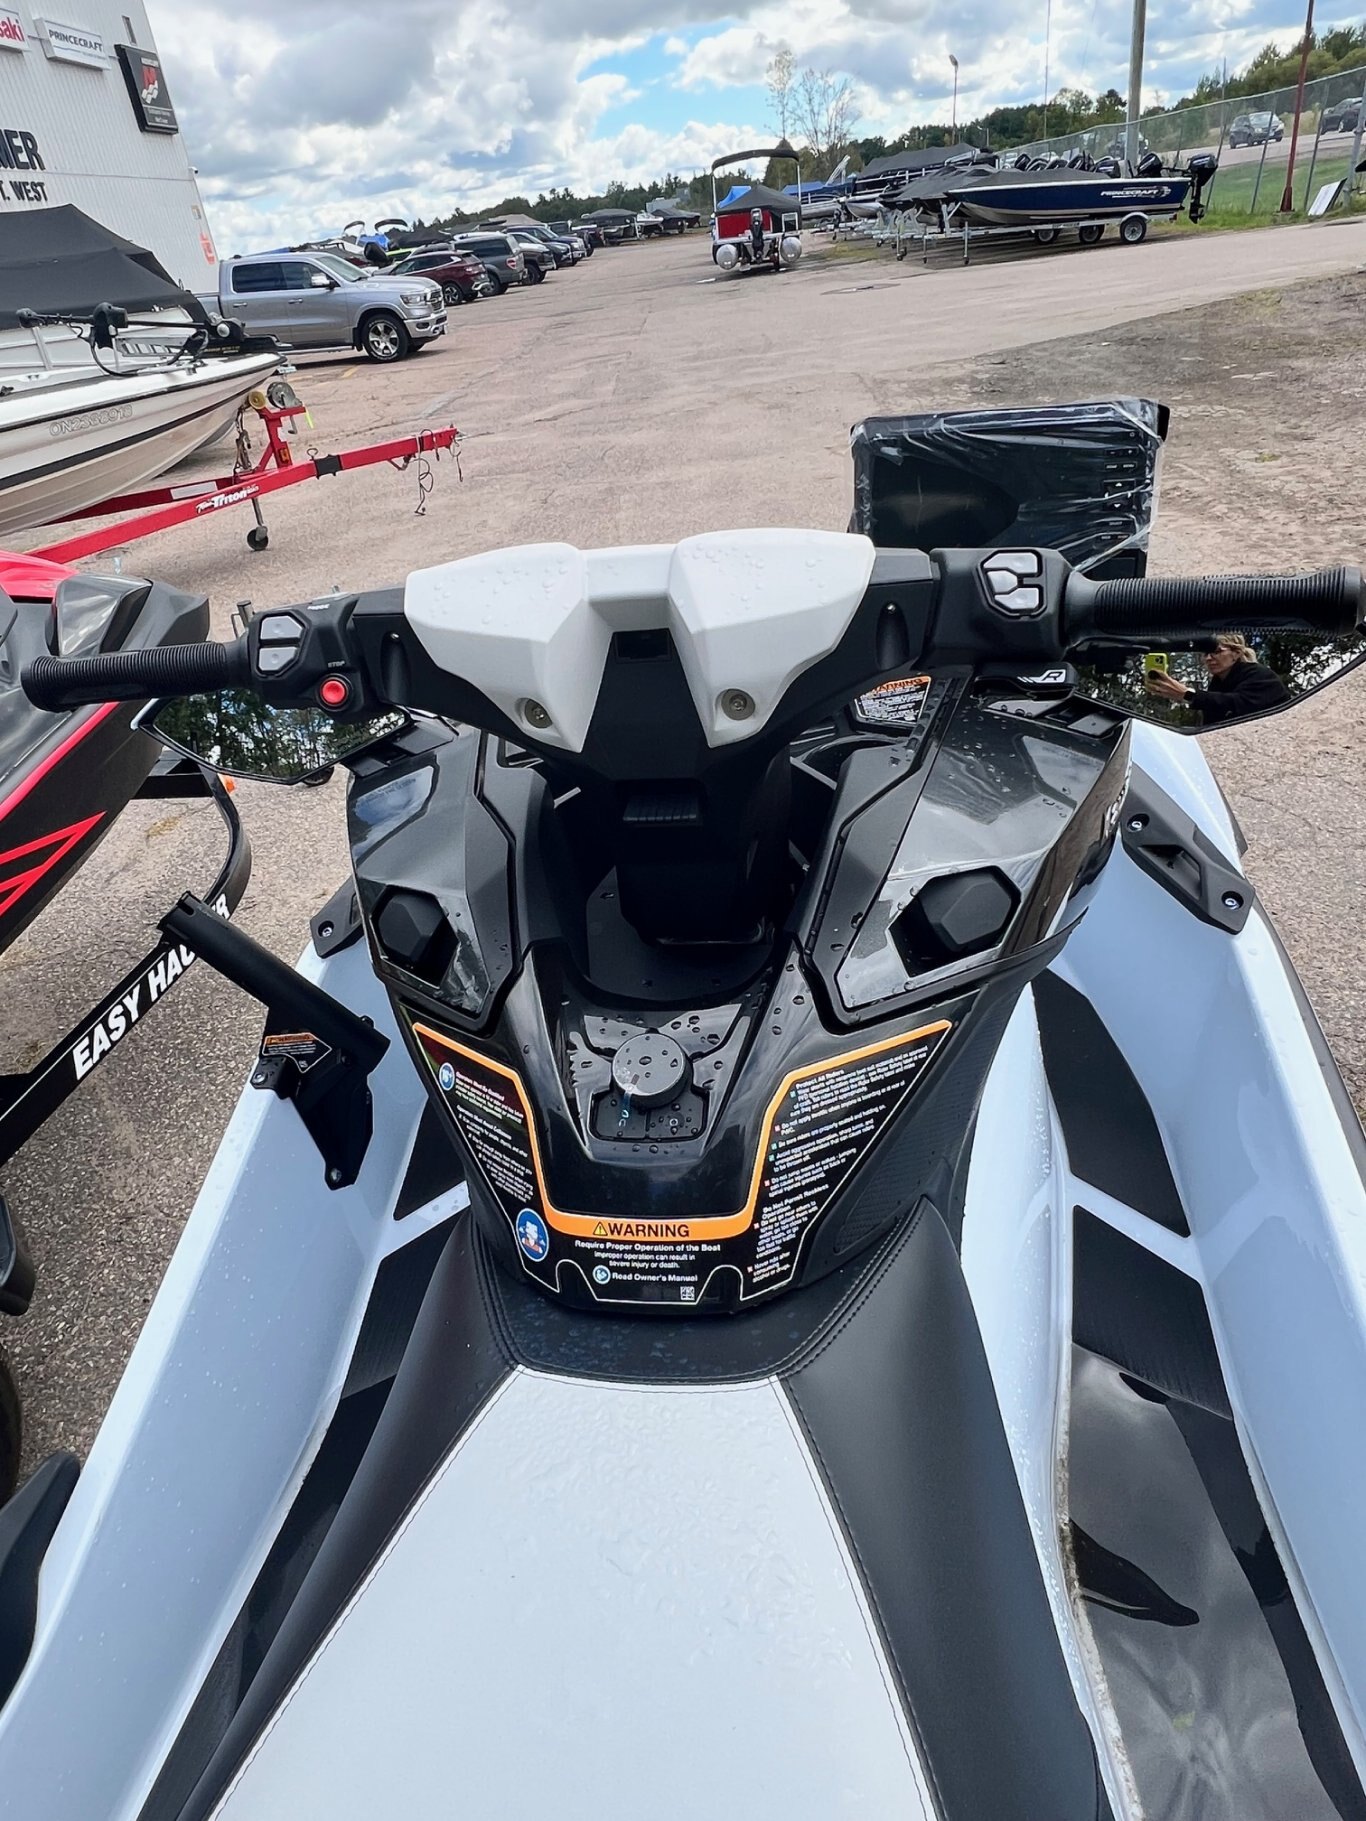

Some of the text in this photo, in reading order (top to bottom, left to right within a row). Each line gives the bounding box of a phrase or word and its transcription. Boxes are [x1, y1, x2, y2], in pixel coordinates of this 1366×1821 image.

[48, 29, 103, 52] PRINCECRAFT
[9, 180, 48, 201] WEST
[212, 488, 248, 508] Triton
[72, 983, 140, 1081] EASY
[607, 1222, 690, 1238] WARNING
[575, 1240, 604, 1249] Require
[606, 1243, 632, 1251] Proper
[634, 1243, 674, 1252] Operation
[701, 1244, 721, 1252] Boat
[631, 1261, 649, 1269] injury
[612, 1272, 698, 1282] Read Owner's Manual
